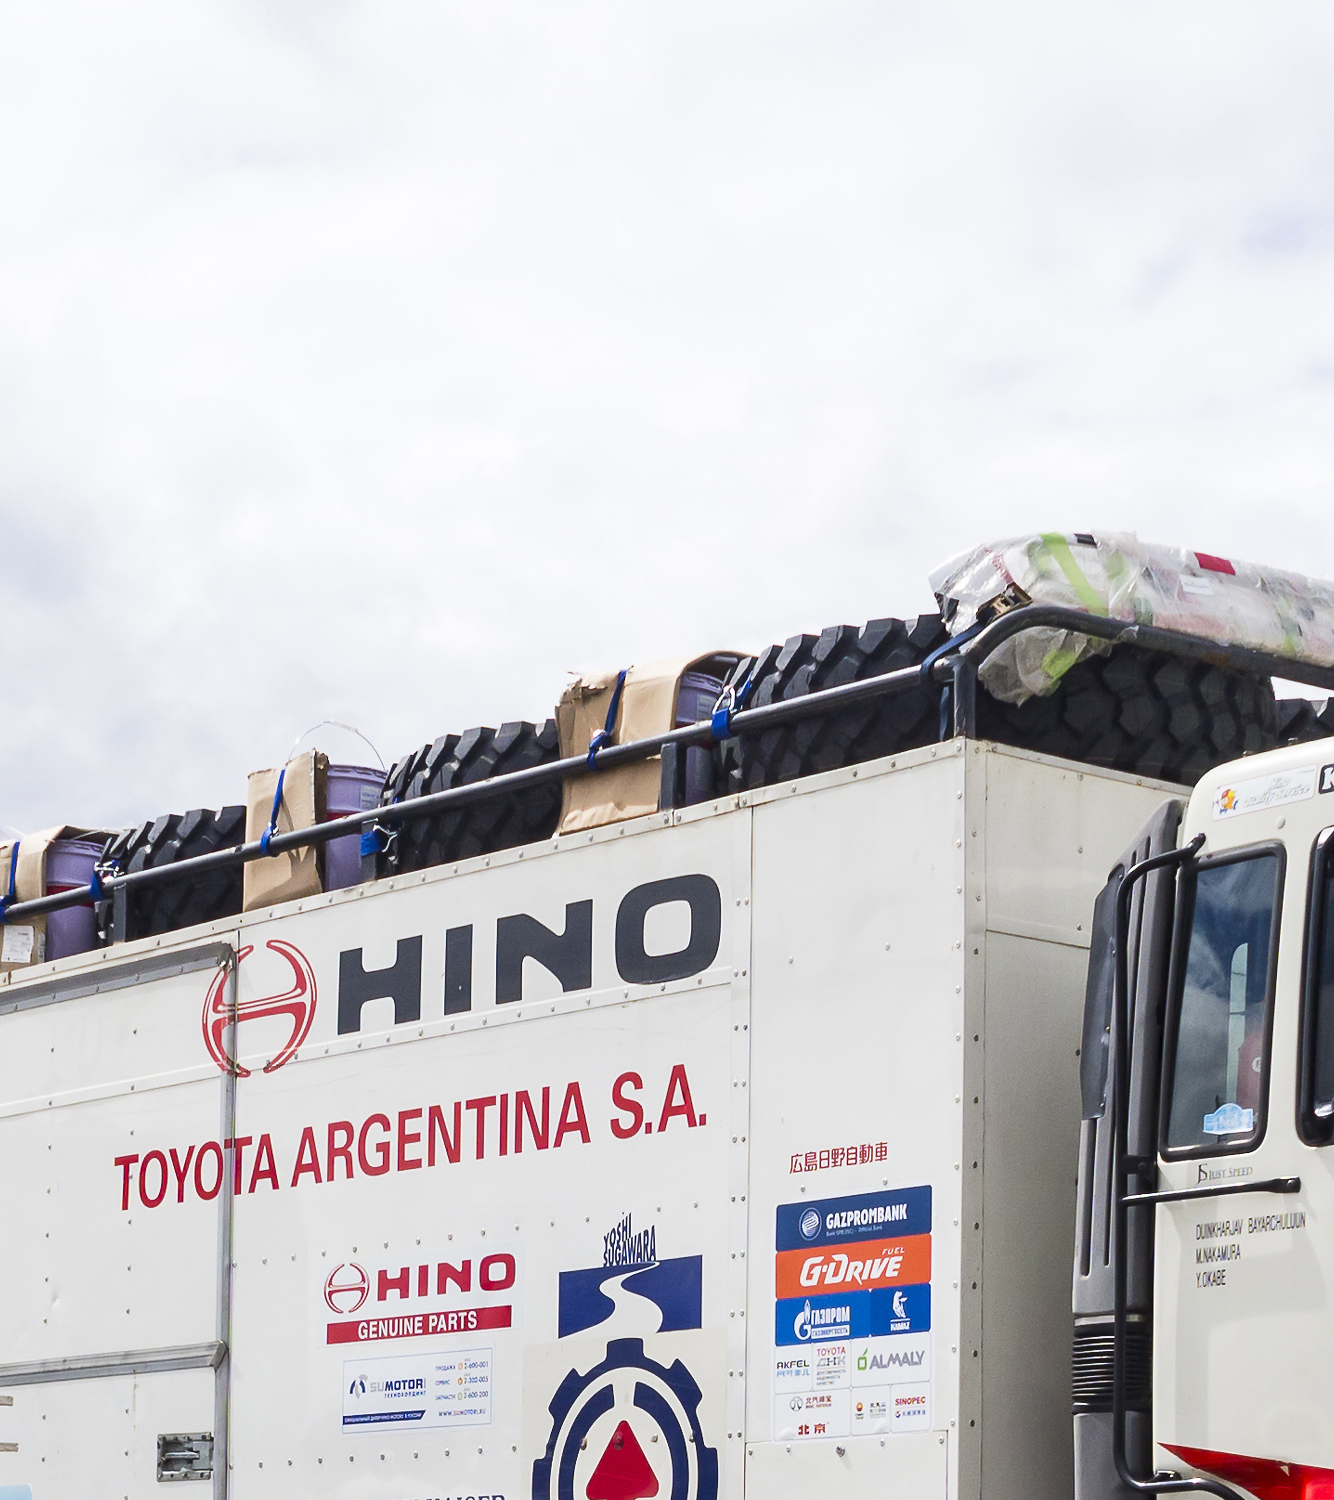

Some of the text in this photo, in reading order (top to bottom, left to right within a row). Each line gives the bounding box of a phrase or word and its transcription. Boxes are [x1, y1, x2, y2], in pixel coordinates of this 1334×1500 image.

[337, 873, 722, 1036] HINO
[114, 1064, 708, 1212] TOYOTA ARGENTINA S.A.
[789, 1142, 888, 1174] 広島日野自動車
[825, 1203, 908, 1230] GAZPROMBANK
[603, 1212, 632, 1249] YOSHI
[603, 1225, 657, 1267] SUGAWARA
[881, 1247, 905, 1255] FUEL
[376, 1253, 516, 1302] HINO
[357, 1310, 478, 1341] GENUINE PARTS
[811, 1306, 851, 1325] ГАЗПРОМ
[776, 1360, 810, 1370] AKFEL
[817, 1346, 846, 1357] TOYOTA
[869, 1350, 925, 1370] ALMALY
[370, 1378, 427, 1393] SUMOTORI
[895, 1396, 926, 1406] SINOPEC
